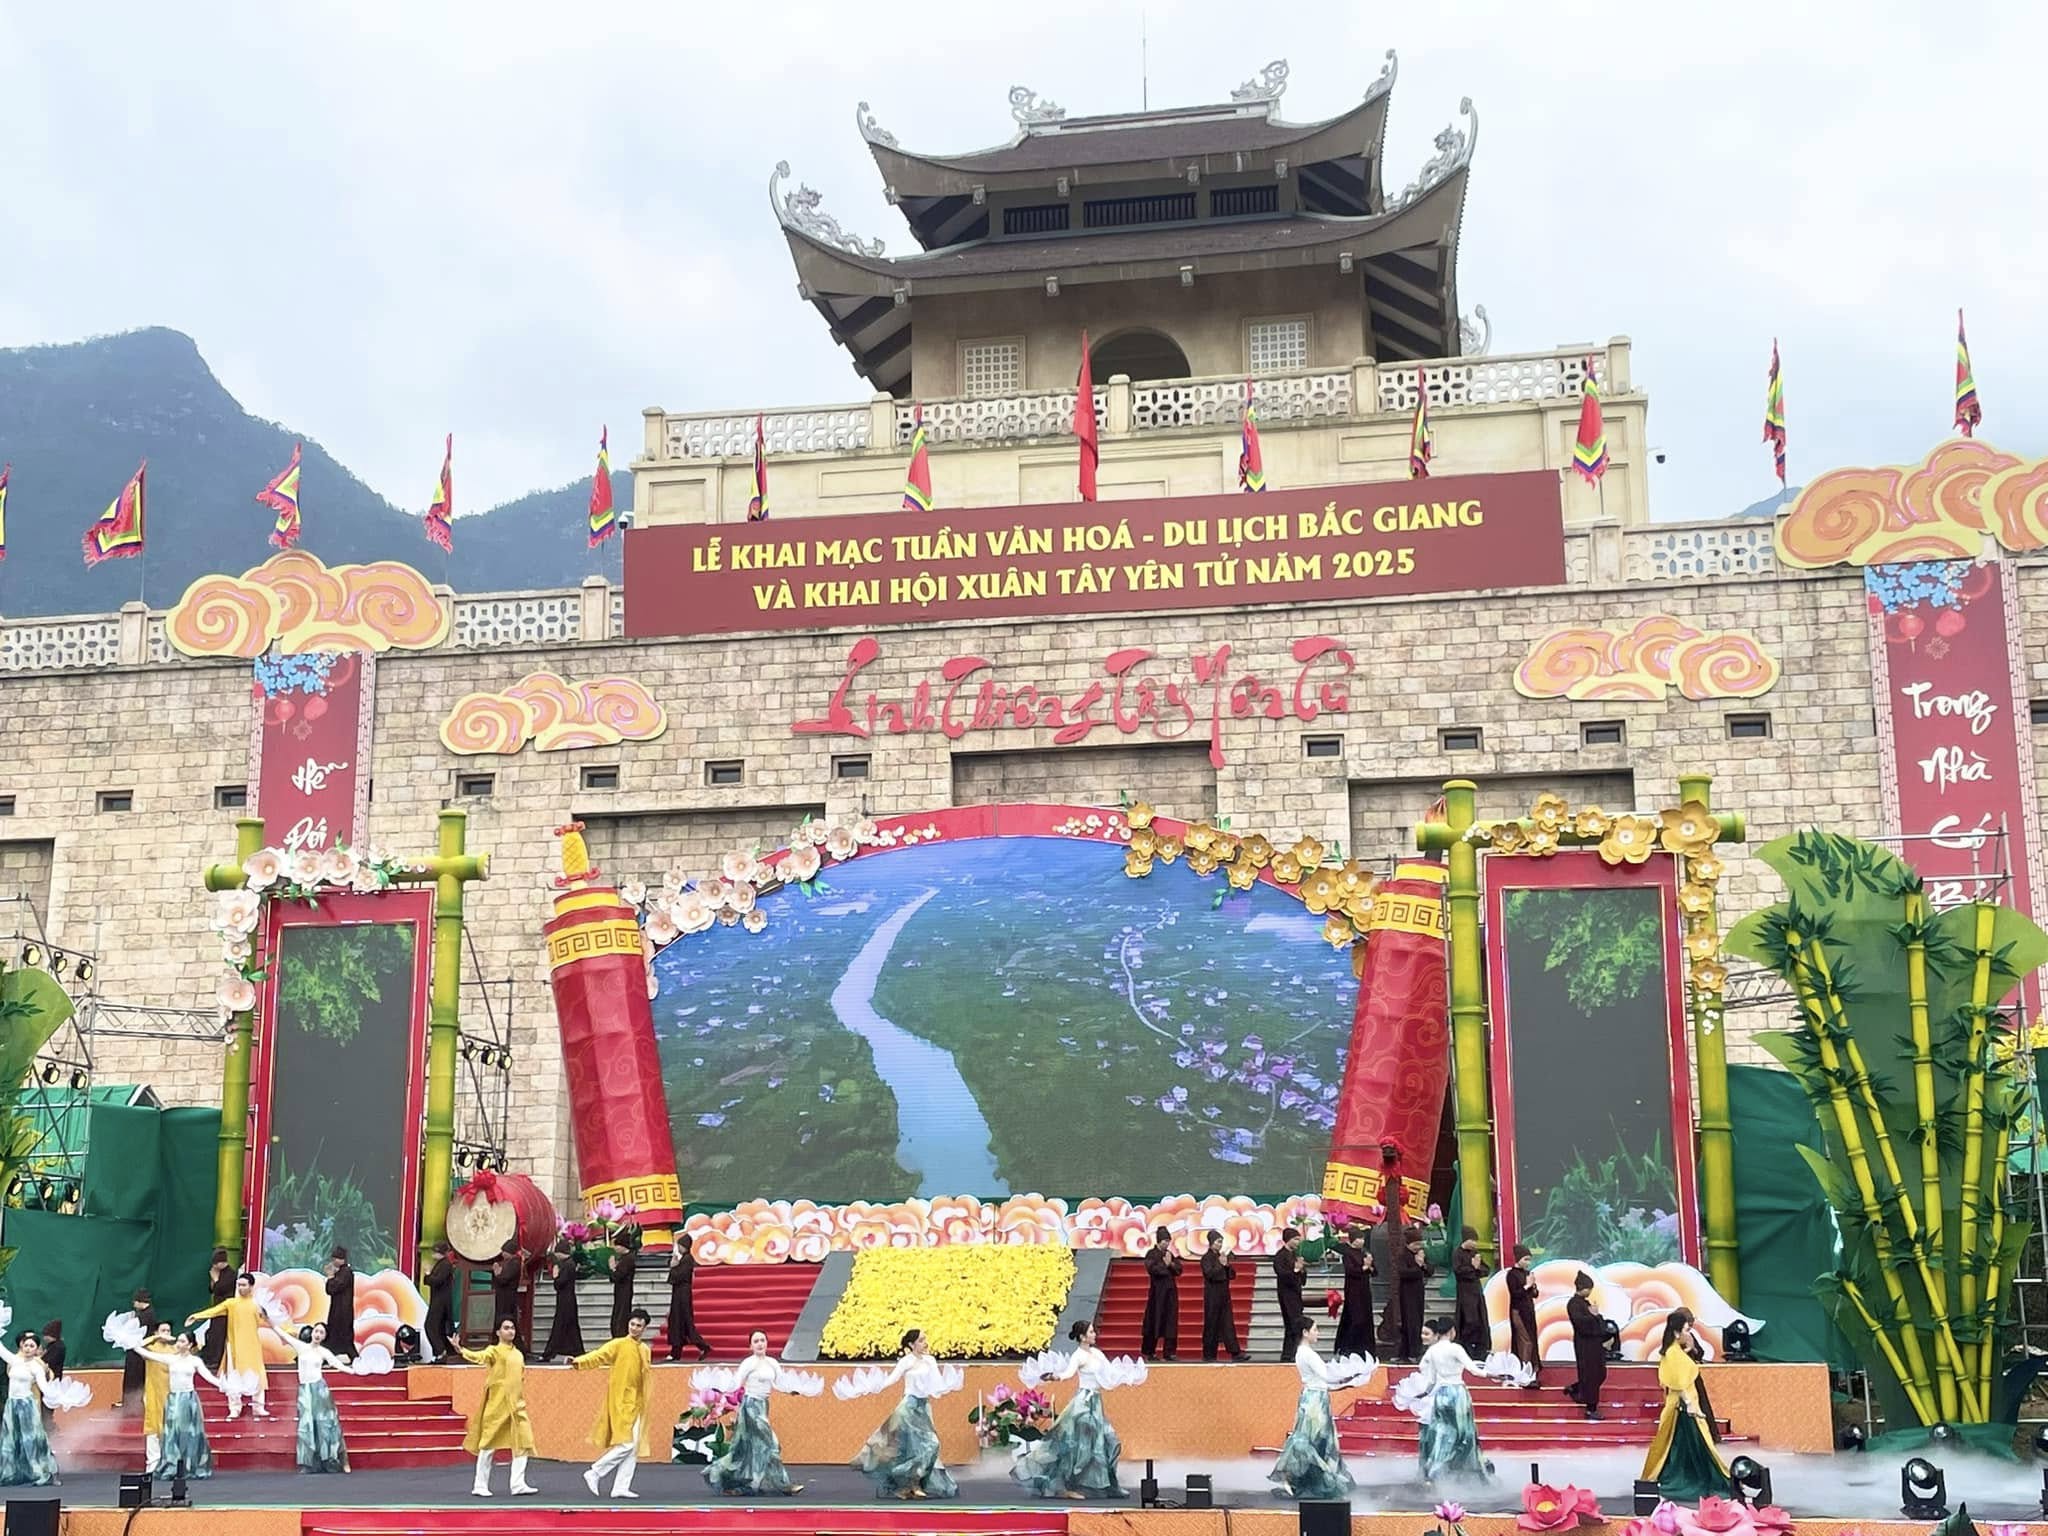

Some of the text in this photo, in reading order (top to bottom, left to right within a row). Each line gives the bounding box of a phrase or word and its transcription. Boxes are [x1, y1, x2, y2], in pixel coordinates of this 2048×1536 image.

[693, 536, 721, 572] LỄ
[731, 541, 806, 570] KHAI
[815, 537, 883, 570] MẠC
[892, 527, 977, 561] TUẦN
[986, 525, 1053, 556] VĂN
[1064, 520, 1134, 552] HOÁ
[1163, 519, 1207, 547] DU
[1217, 513, 1288, 549] LỊCH
[1298, 503, 1363, 539] BẮC
[1372, 499, 1483, 533] GIANG
[753, 547, 1416, 611] VÀ KHAI HỘI XUÂN TÂY YÊN TỬ NĂM 2025
[791, 637, 935, 741] Linh
[1901, 681, 1999, 736] Trong
[1917, 745, 1993, 796] Nhà
[1929, 811, 1993, 849] Có
